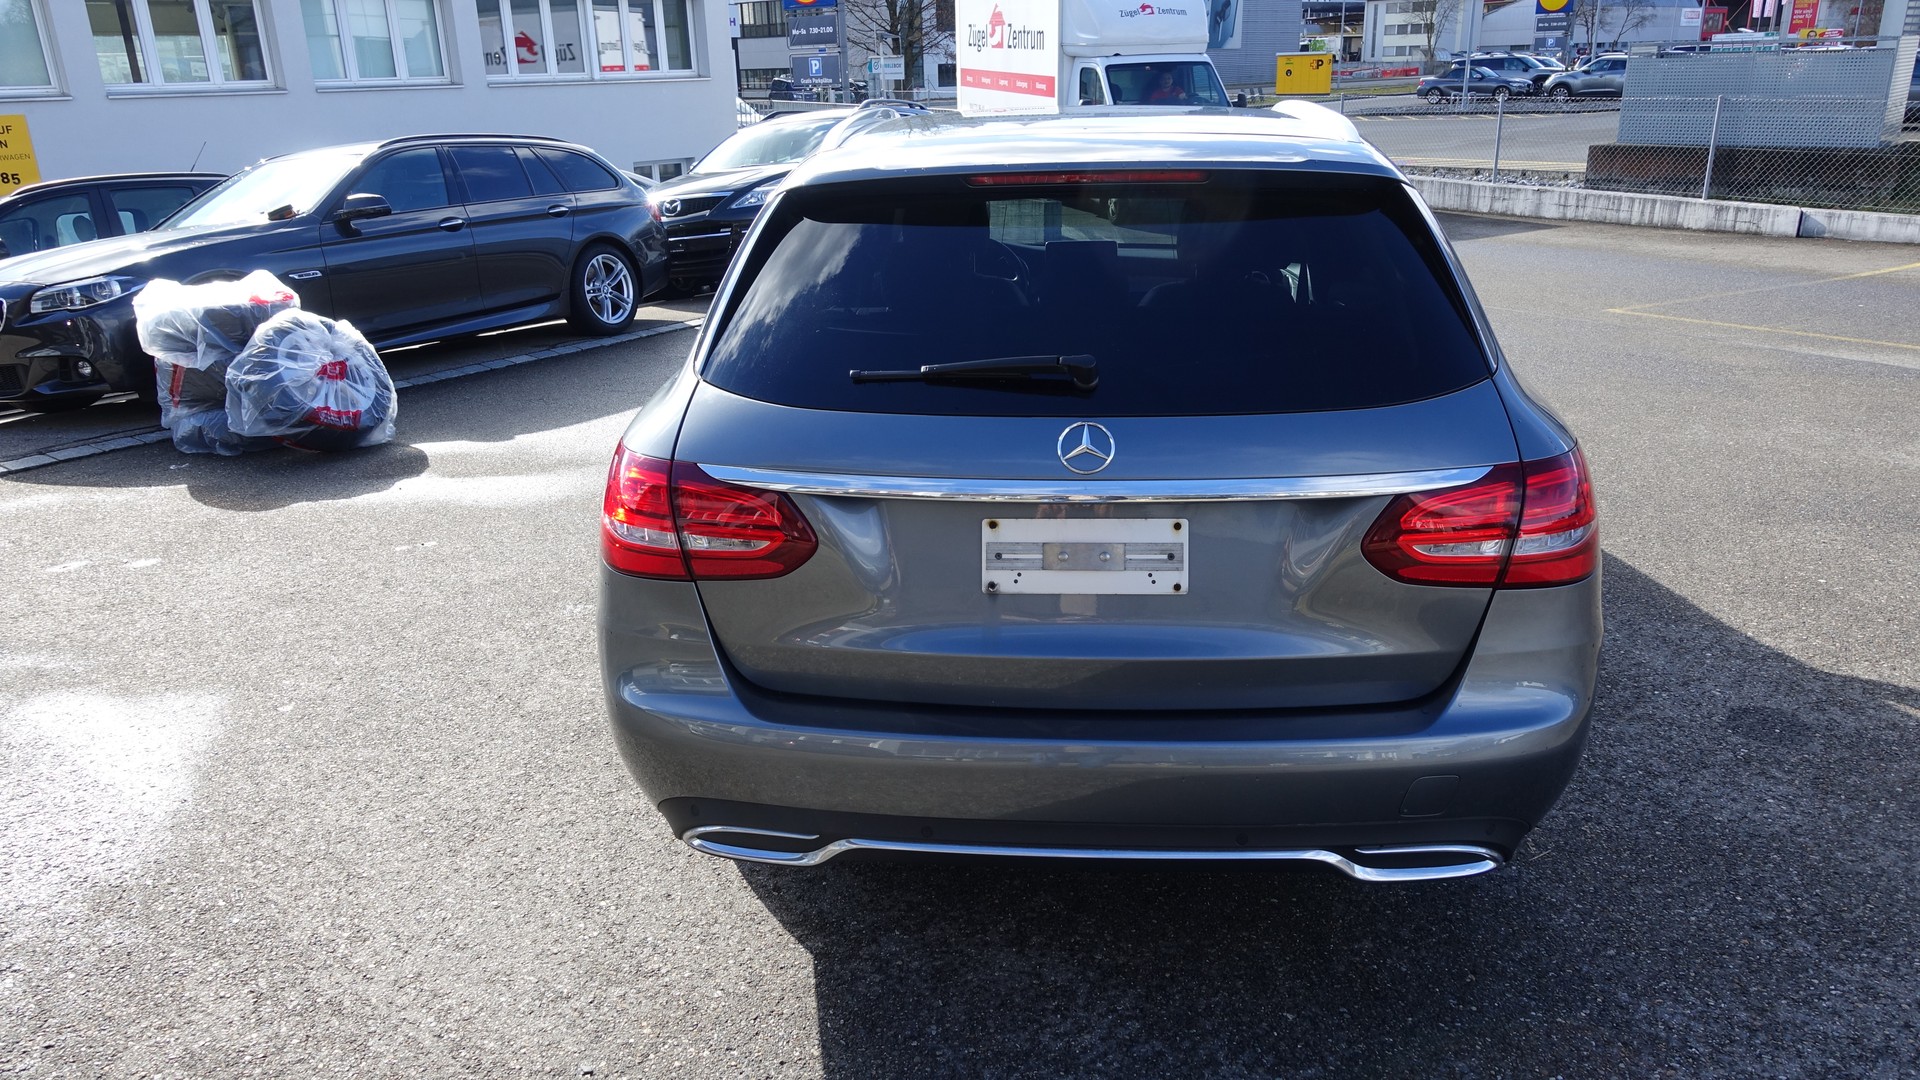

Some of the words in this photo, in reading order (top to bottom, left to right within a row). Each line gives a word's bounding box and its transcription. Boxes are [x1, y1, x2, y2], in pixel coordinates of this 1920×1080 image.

[1119, 8, 1140, 18] Zügel
[1156, 7, 1187, 16] Zentrum
[968, 24, 988, 52] Zügel
[1007, 23, 1045, 50] Zentrum
[810, 59, 820, 74] P
